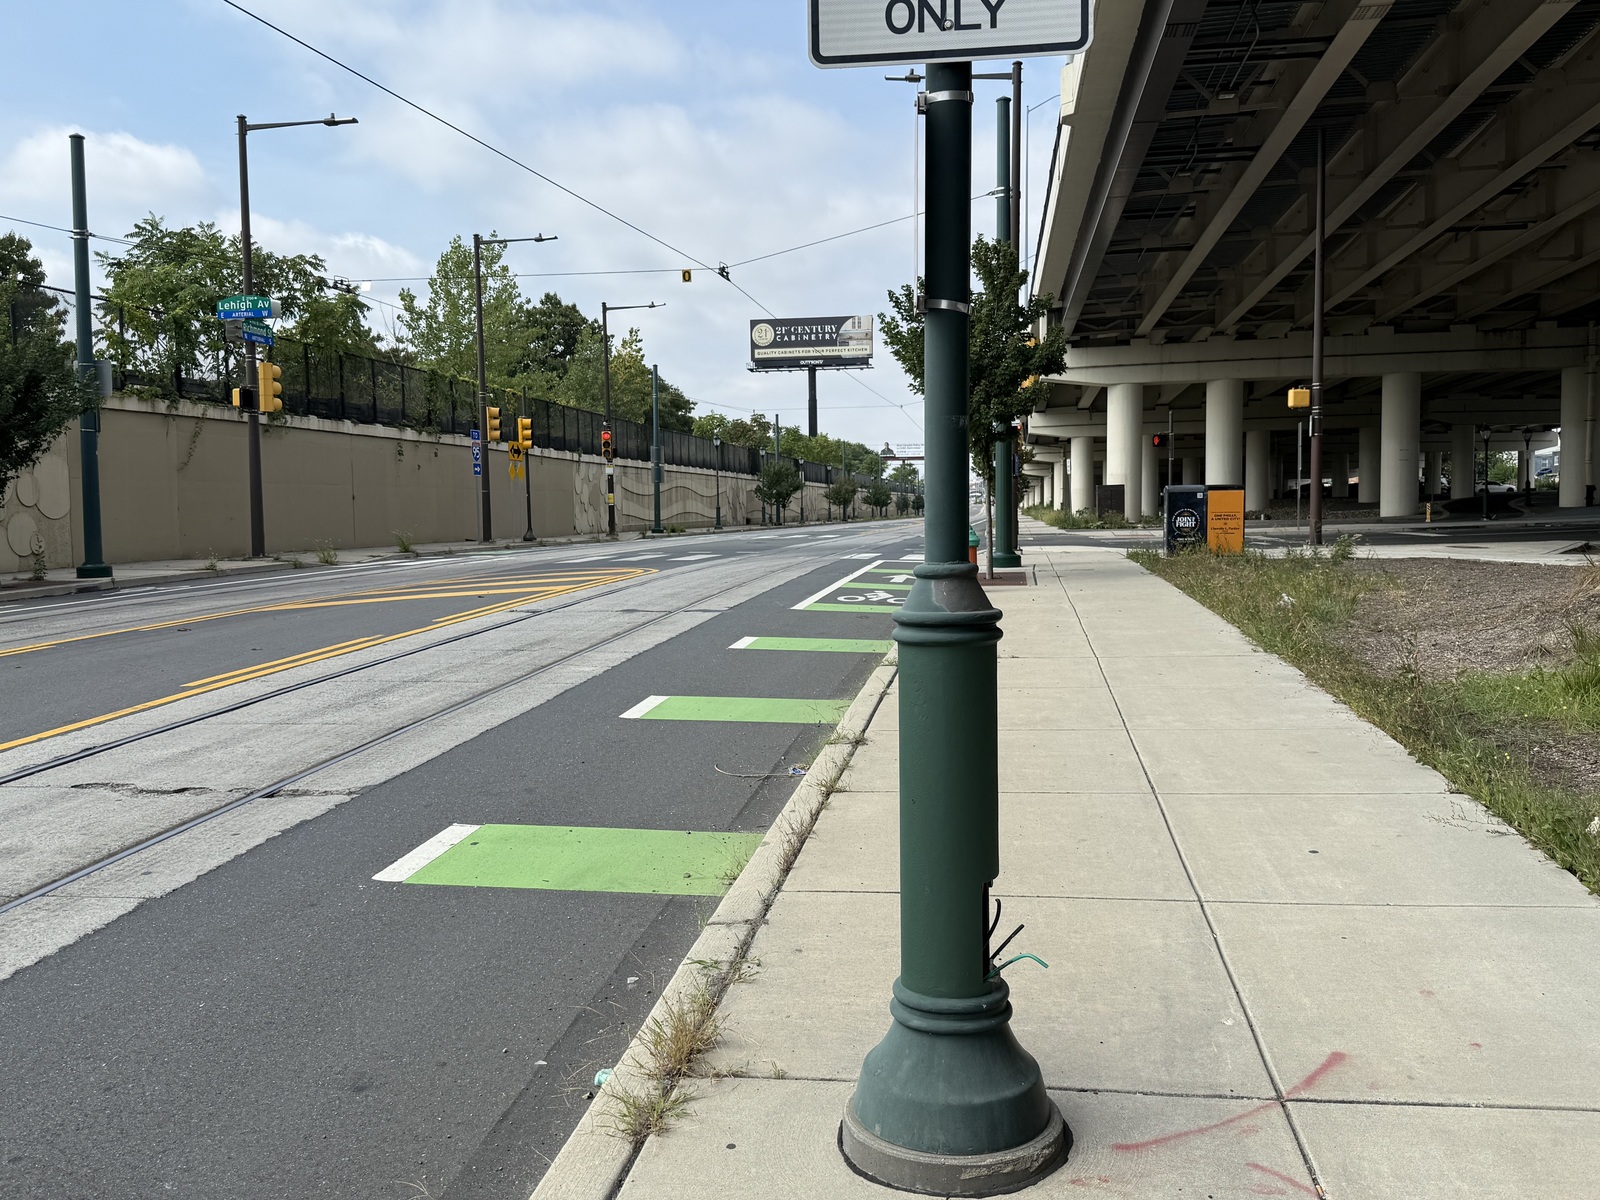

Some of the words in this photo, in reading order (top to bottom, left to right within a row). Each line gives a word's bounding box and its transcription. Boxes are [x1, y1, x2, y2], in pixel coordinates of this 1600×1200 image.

[884, 0, 1005, 34] ONLY
[218, 300, 252, 311] Lehigh
[257, 300, 269, 308] Av
[791, 325, 838, 334] CENTURY
[776, 333, 838, 342] CABINETRY
[473, 446, 480, 458] 95
